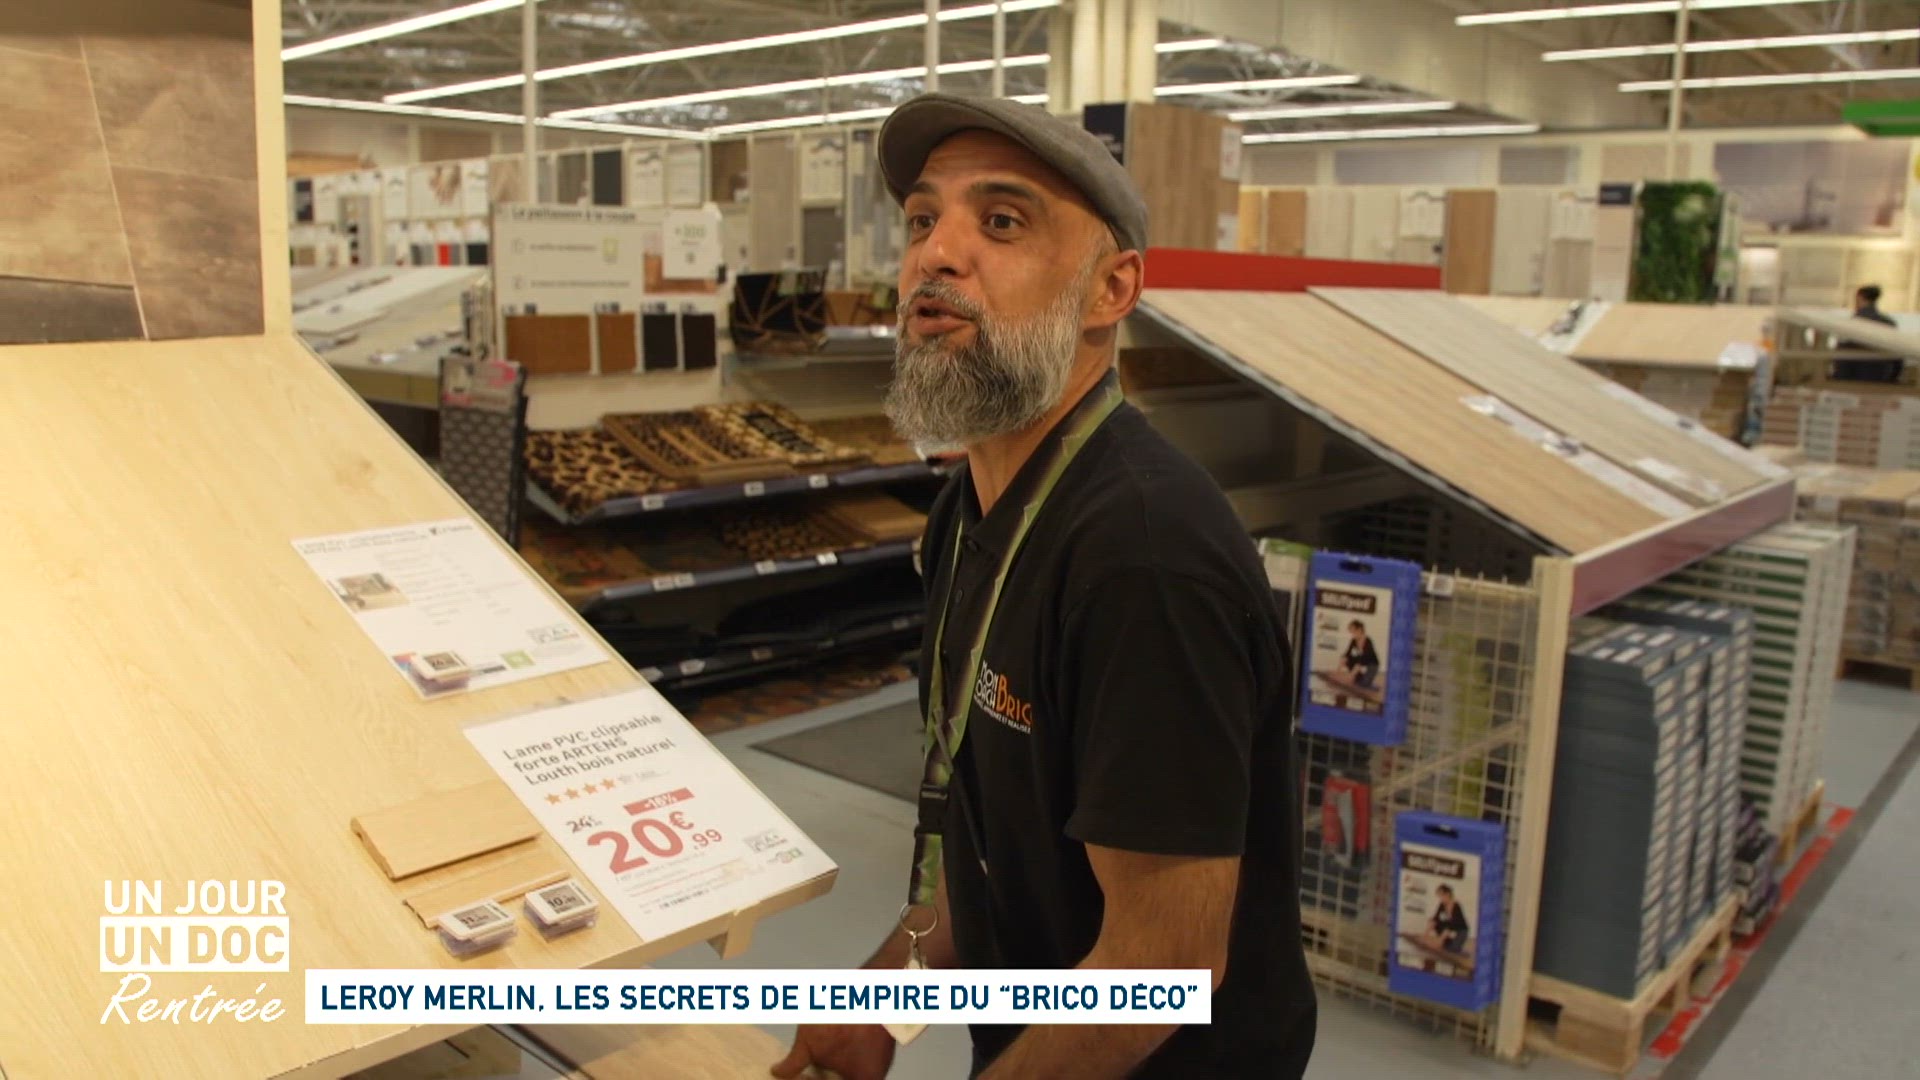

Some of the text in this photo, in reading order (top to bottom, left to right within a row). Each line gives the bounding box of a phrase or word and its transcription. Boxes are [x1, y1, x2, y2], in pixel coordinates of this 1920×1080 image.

[976, 673, 1033, 726] OACH BRIC
[502, 713, 662, 762] Lame PVC clipsable
[514, 737, 628, 776] forte ARTENS
[524, 737, 677, 787] Louth bois naturel
